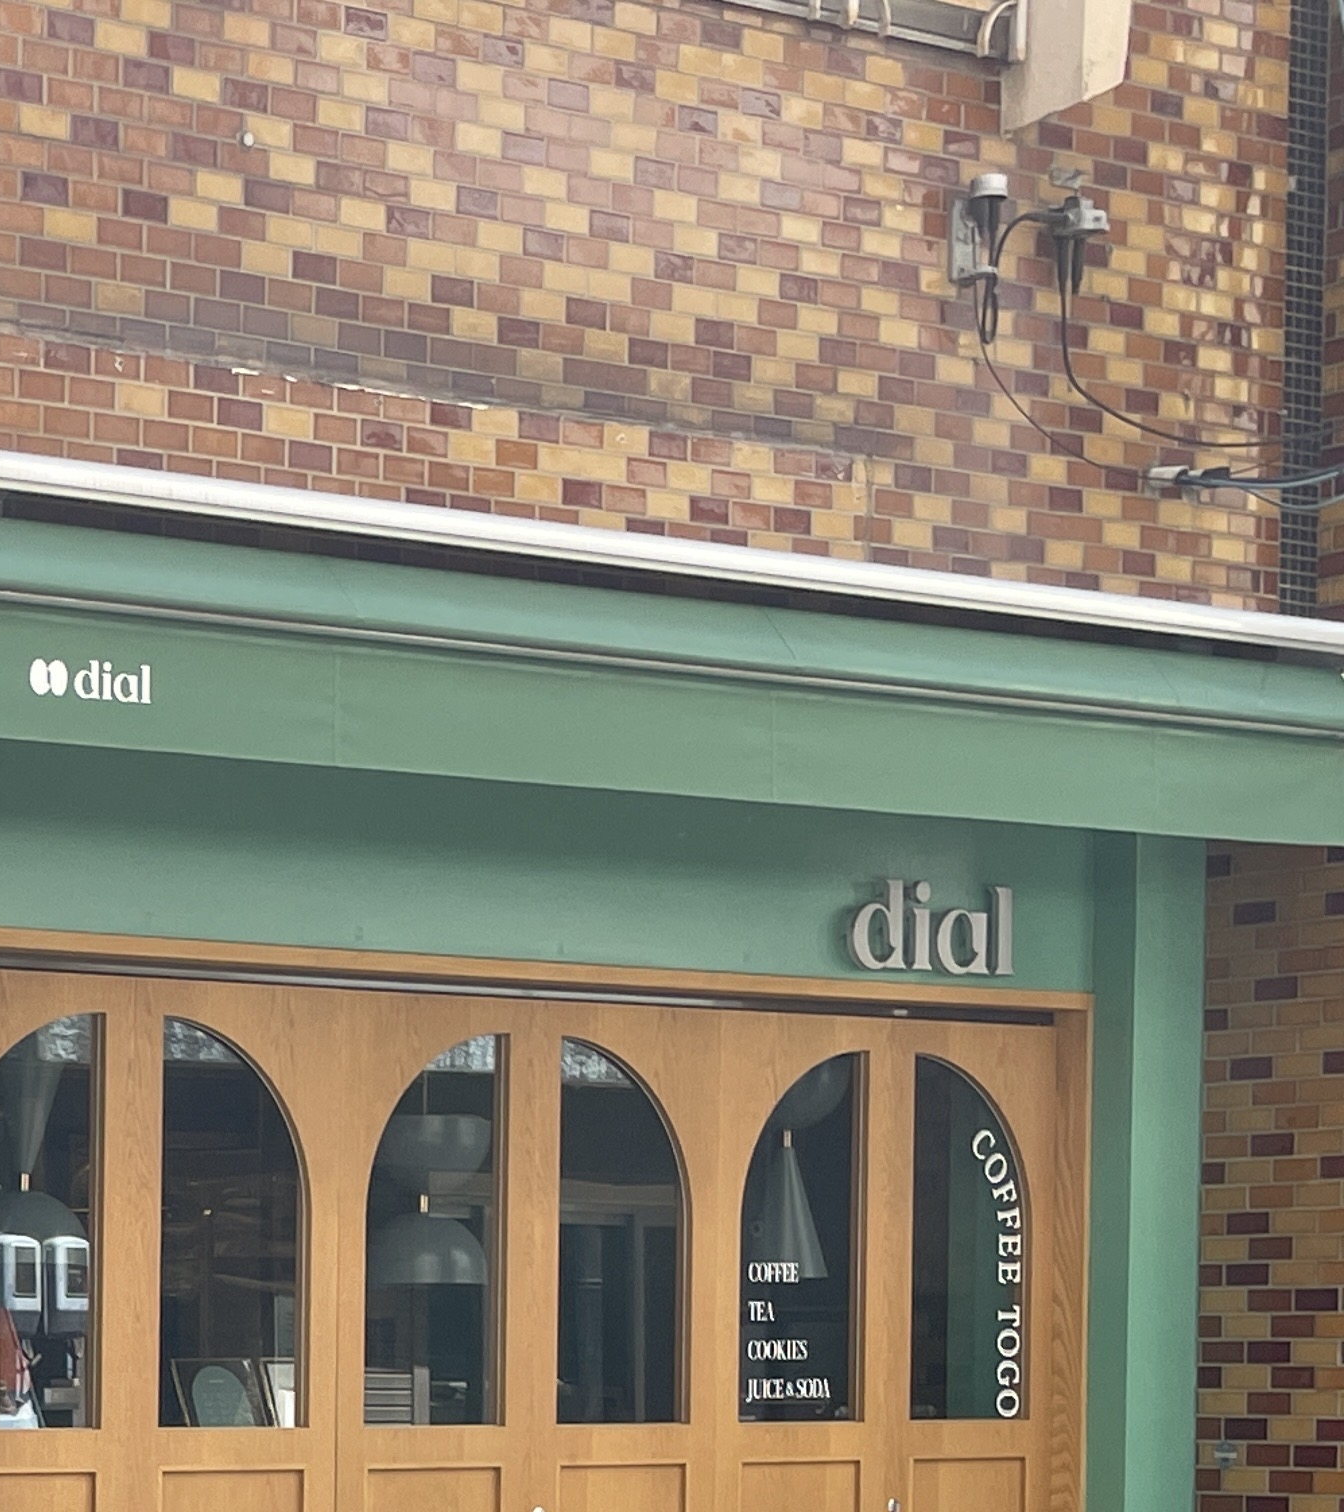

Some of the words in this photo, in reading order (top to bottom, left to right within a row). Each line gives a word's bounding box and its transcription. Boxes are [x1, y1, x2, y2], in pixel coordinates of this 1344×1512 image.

[74, 659, 152, 704] dial
[850, 879, 1015, 976] dial
[971, 1129, 1022, 1285] COFFEE
[747, 1262, 799, 1283] COFFEE
[748, 1301, 775, 1322] TEA
[747, 1340, 808, 1361] COOKIES
[995, 1304, 1021, 1418] TOGO
